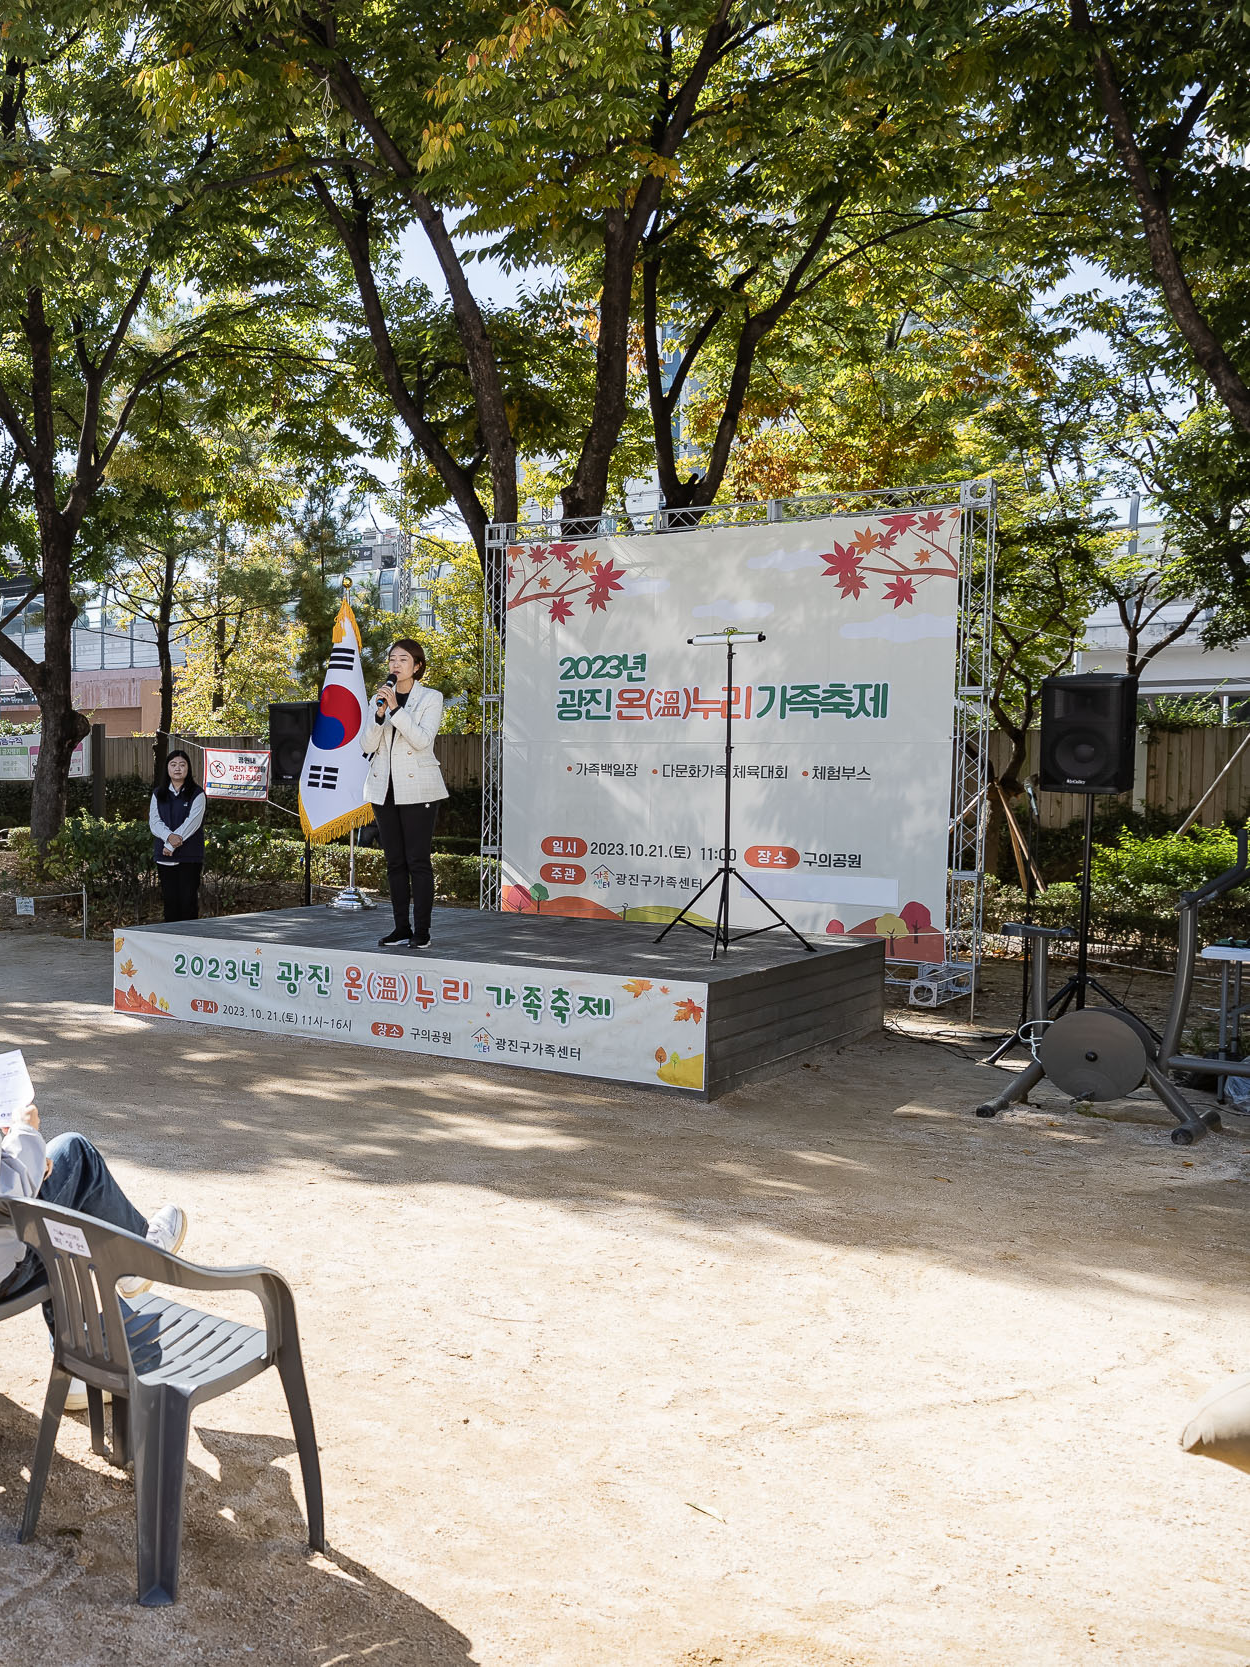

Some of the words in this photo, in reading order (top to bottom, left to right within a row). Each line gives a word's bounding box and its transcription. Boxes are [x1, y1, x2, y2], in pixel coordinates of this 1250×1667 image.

[558, 653, 647, 683] 2023년
[556, 688, 612, 721] 광진
[756, 682, 889, 720] 가족축제
[575, 762, 638, 778] 가족백일장
[662, 764, 727, 779] 다문화가족
[732, 764, 788, 780] 체육대회
[811, 766, 872, 782] 체험부스
[552, 840, 578, 854] 일시
[700, 847, 737, 862] 11:00
[757, 850, 789, 865] 장소
[803, 851, 862, 869] 구의공원
[551, 867, 577, 881] 주관
[615, 872, 703, 890] 광진구가족센터
[174, 953, 261, 987] 2023년
[276, 961, 331, 995] 광진
[485, 985, 612, 1024] 가족축제
[410, 1027, 452, 1045] 구의공원
[495, 1037, 581, 1061] 광진구가족센터
